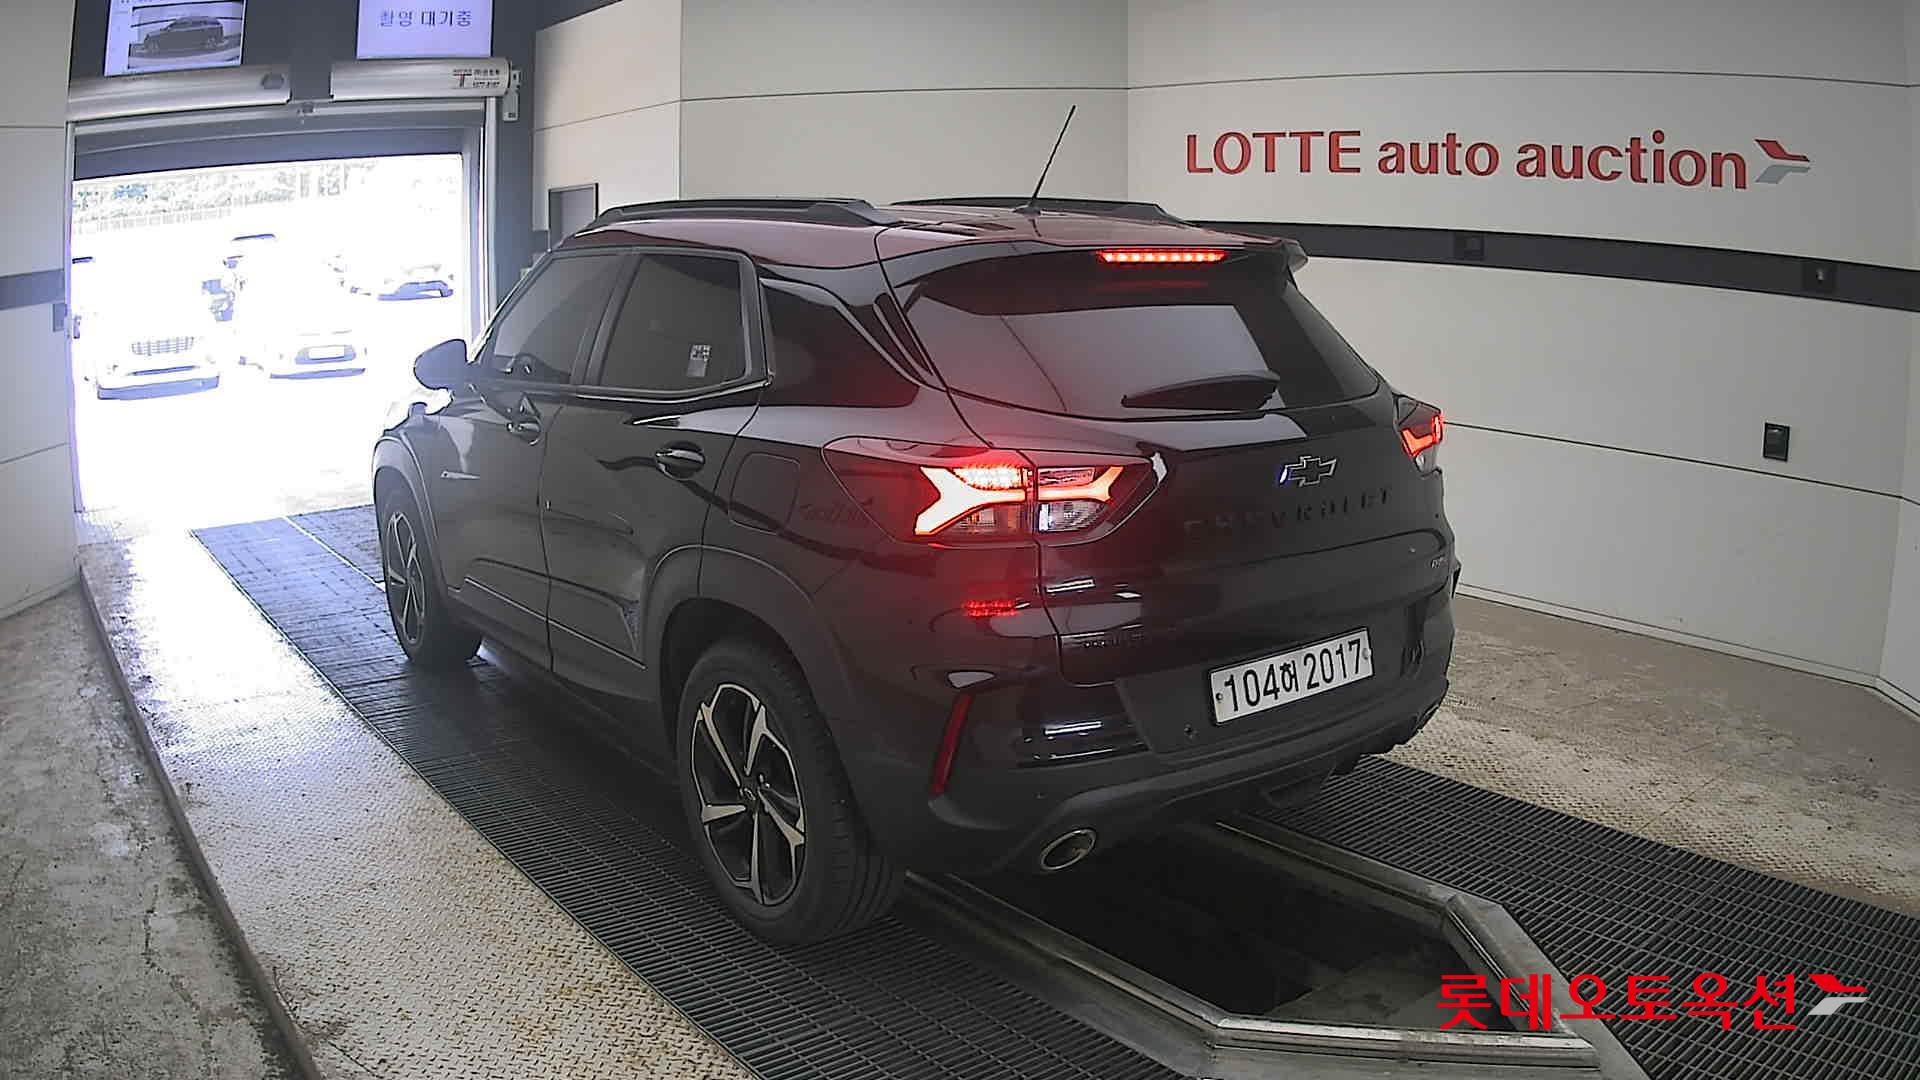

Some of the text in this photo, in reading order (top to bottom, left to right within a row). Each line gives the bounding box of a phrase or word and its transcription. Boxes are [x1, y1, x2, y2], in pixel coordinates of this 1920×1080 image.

[421, 11, 472, 27] 대기중
[1187, 130, 1747, 190] LOTTE auto auction
[1224, 638, 1361, 712] 104허 2017
